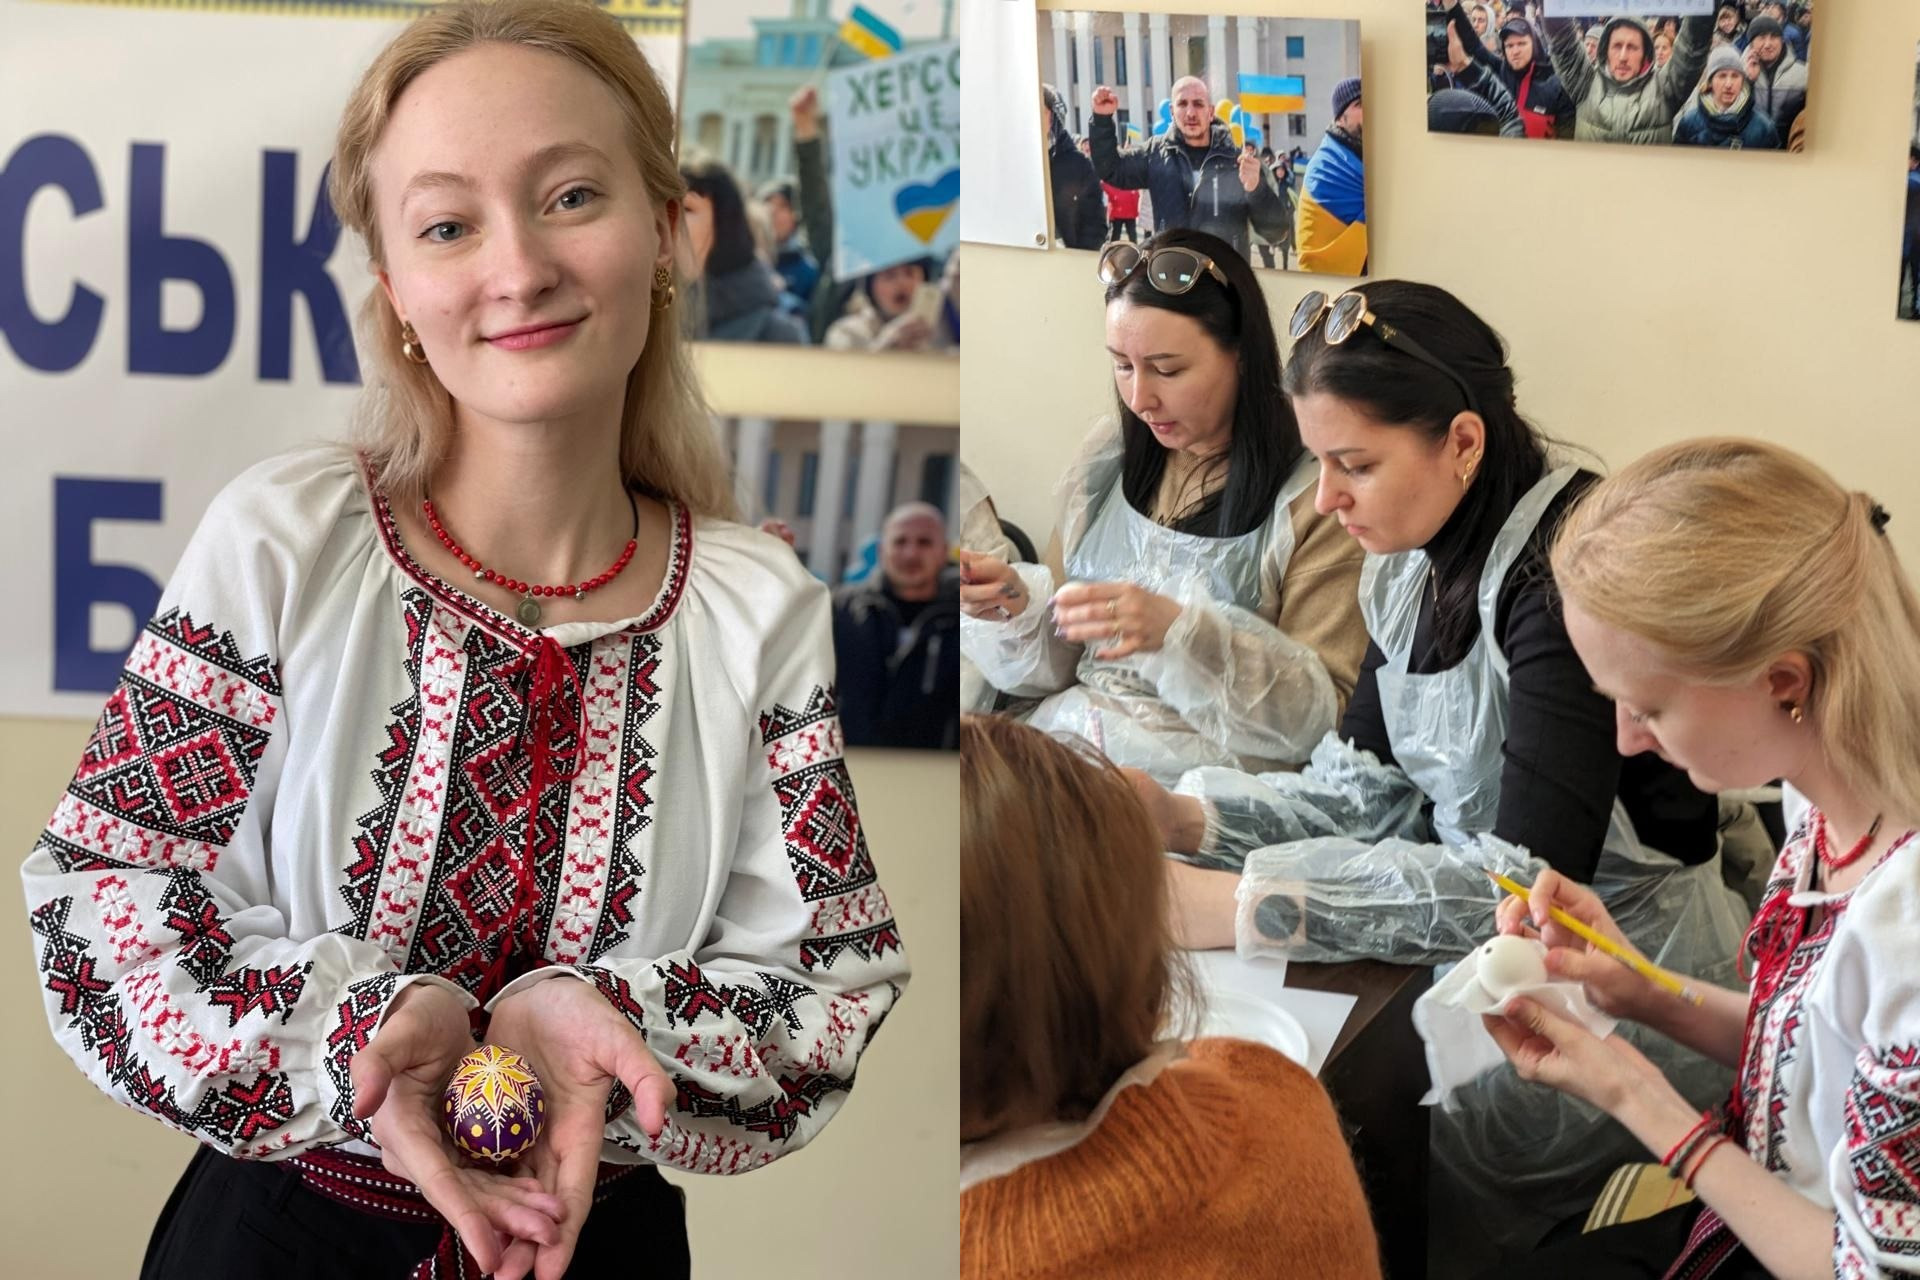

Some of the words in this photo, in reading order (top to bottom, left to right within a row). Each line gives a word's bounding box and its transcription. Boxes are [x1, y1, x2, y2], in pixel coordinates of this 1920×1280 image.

[0, 133, 363, 387] СЬК
[849, 137, 960, 188] УКРА
[54, 477, 165, 693] Б
